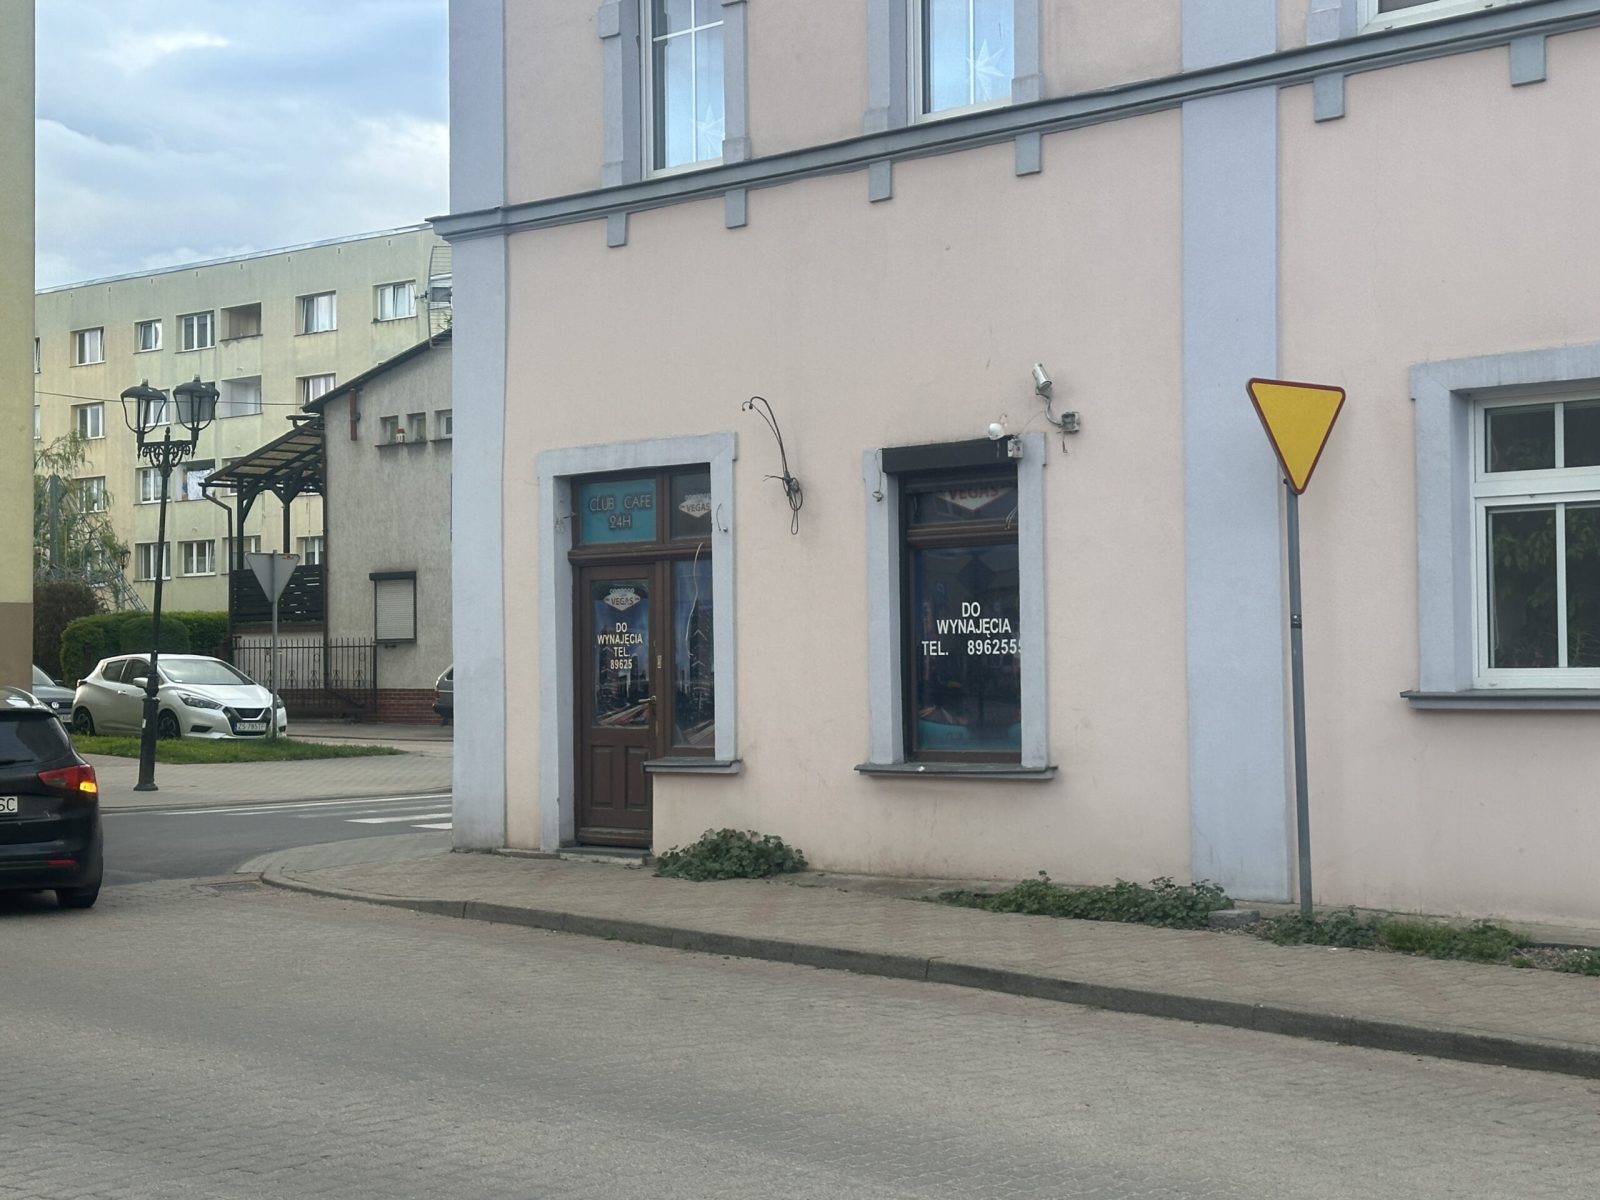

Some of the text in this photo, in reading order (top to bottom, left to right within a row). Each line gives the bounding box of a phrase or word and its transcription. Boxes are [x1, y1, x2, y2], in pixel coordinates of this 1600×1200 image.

[589, 494, 652, 512] CLUB CAFE
[686, 503, 711, 512] VEGAS
[609, 515, 632, 529] 24H
[611, 597, 634, 606] VEGAS
[961, 602, 981, 617] DO
[615, 622, 628, 633] DO
[936, 618, 1012, 638] WYNAJĘCIA
[597, 633, 643, 647] WYNAJĘCIA
[921, 641, 949, 655] TEL.
[610, 658, 633, 670] 89625
